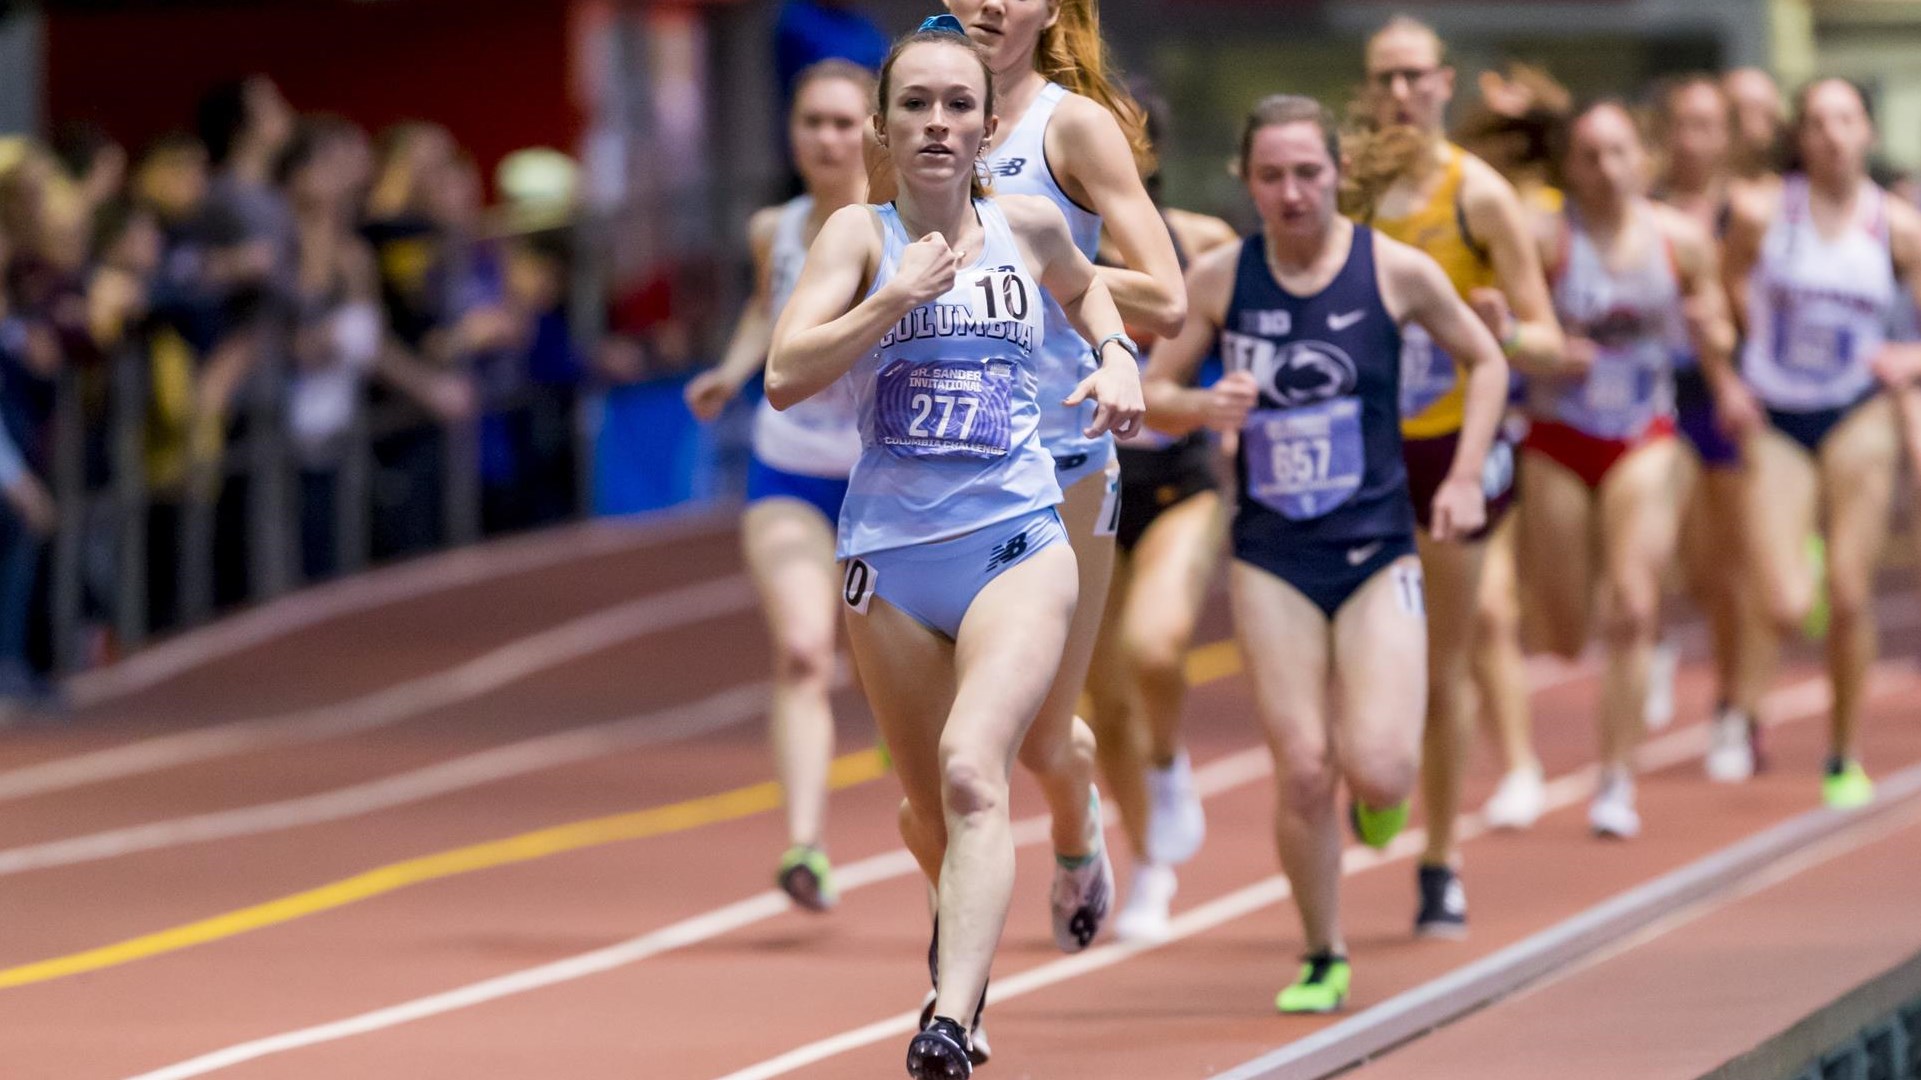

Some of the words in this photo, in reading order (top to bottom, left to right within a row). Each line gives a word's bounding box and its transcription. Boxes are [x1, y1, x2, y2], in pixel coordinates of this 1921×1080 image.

[975, 274, 1028, 320] 10
[908, 378, 982, 392] INVITATIONAL
[933, 369, 982, 382] SANDER
[908, 393, 979, 440] 277
[884, 436, 941, 447] COLUMBIA
[943, 440, 1007, 455] CHALLENGE
[1271, 438, 1332, 484] 657
